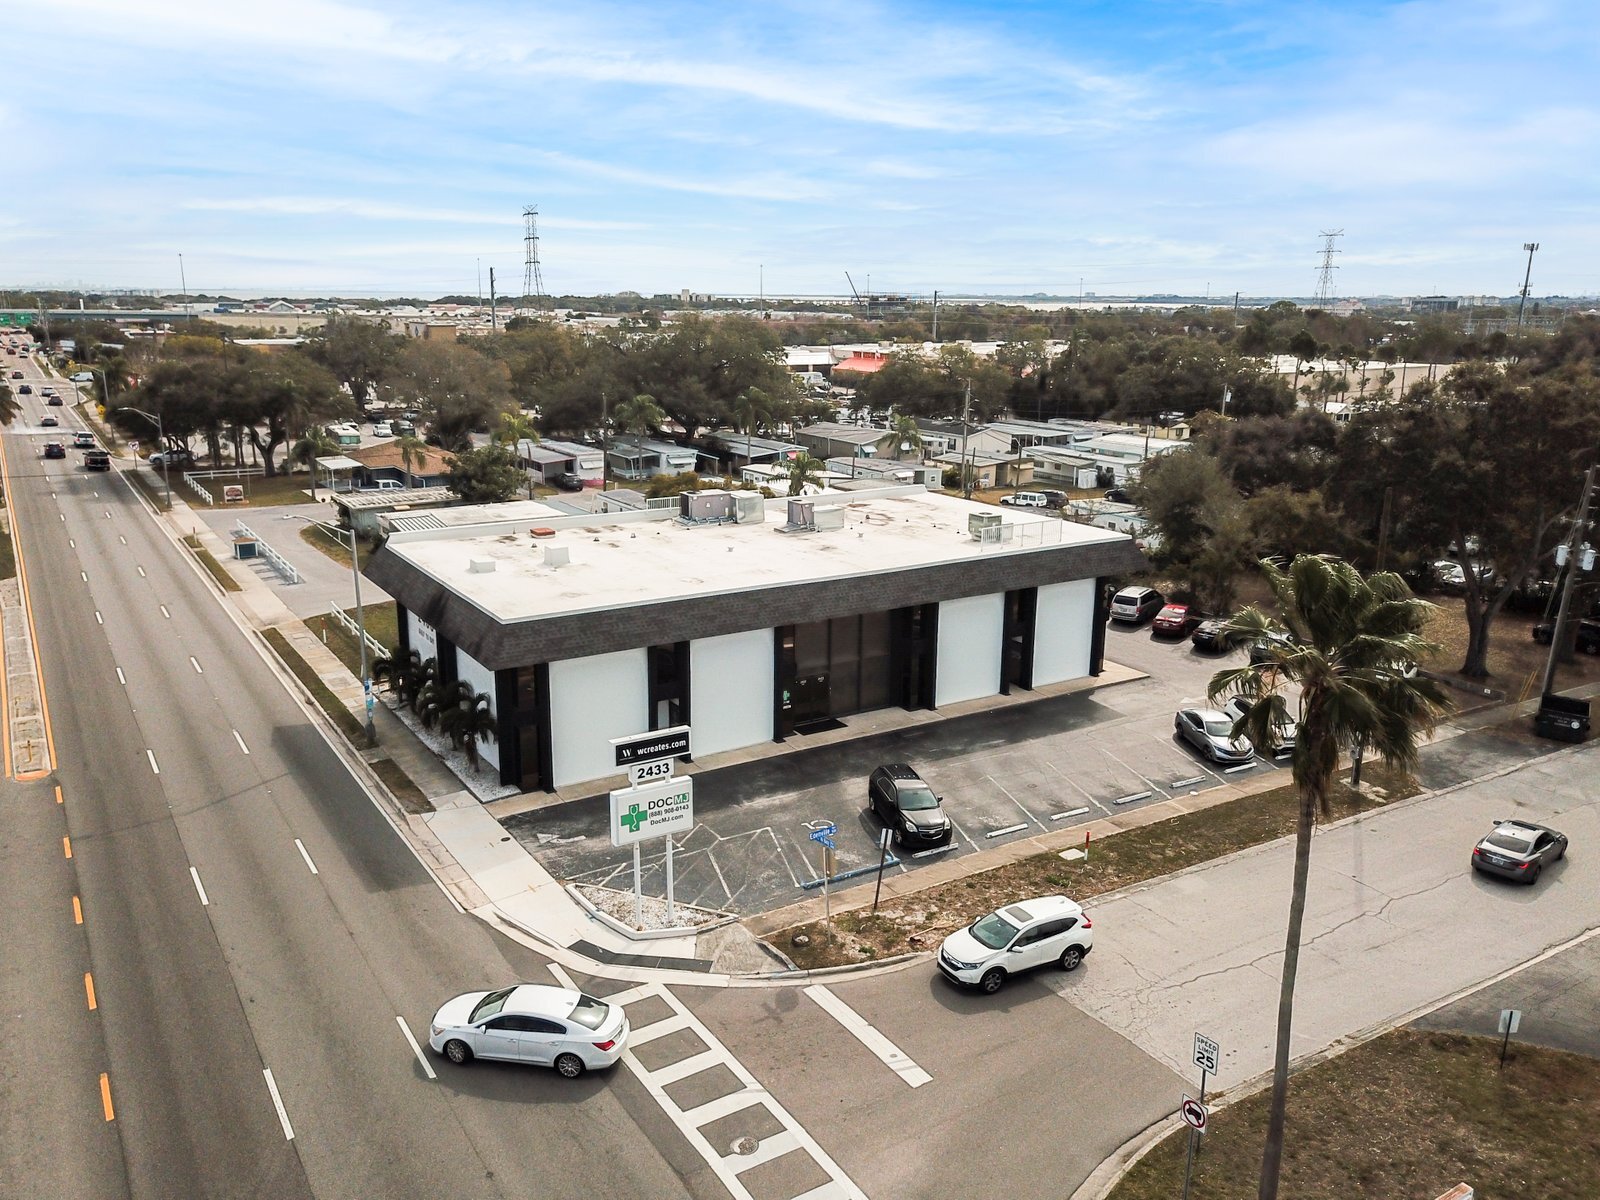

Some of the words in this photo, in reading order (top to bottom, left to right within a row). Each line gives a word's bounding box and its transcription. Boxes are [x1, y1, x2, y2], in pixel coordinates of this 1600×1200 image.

[637, 740, 686, 755] wcreates.com
[637, 762, 670, 779] 2433
[650, 814, 684, 826] DocMJ.com
[1196, 1036, 1217, 1052] SPEED
[1198, 1044, 1214, 1056] LIMIT
[1196, 1051, 1214, 1070] 25
